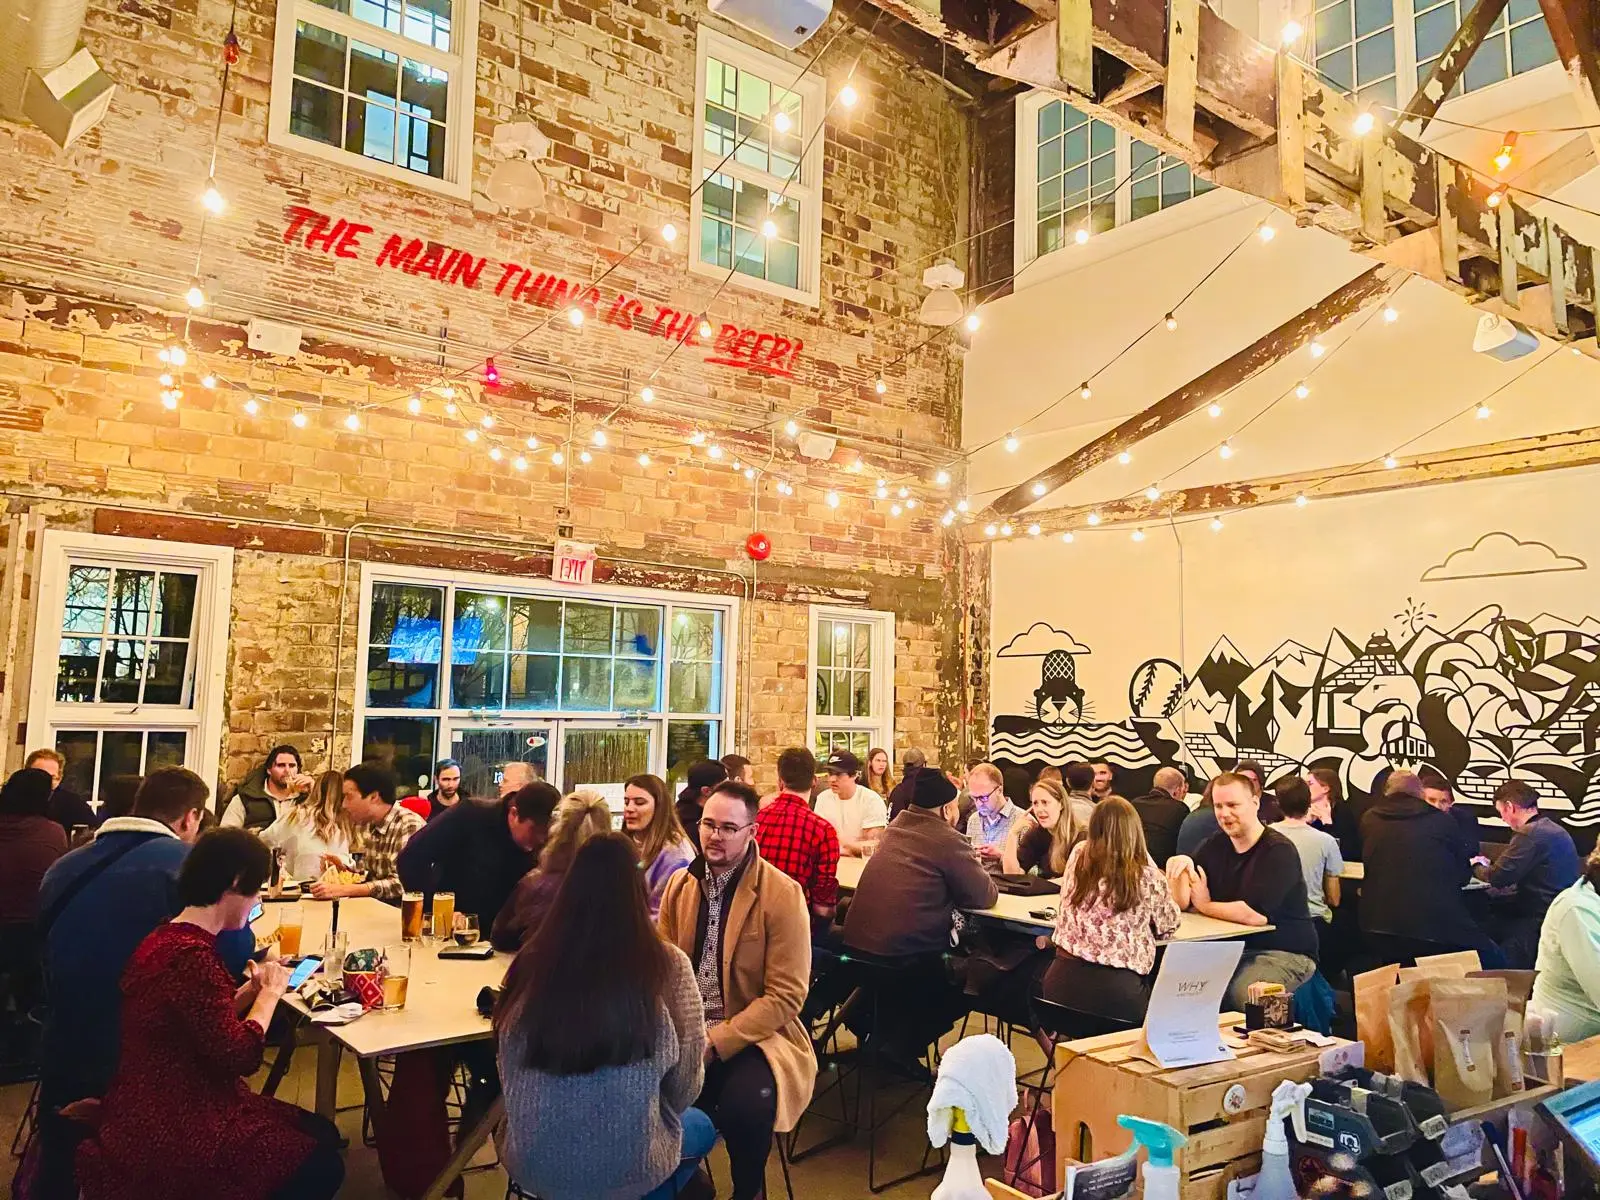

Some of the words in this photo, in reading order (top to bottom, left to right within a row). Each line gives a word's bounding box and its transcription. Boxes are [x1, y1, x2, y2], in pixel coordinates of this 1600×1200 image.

[283, 205, 373, 260] THE
[375, 233, 487, 289] MAIN
[494, 262, 600, 320] THING
[604, 294, 643, 331] IS
[649, 305, 702, 347] THE
[559, 557, 587, 582] EXIT
[1177, 980, 1208, 993] WHY
